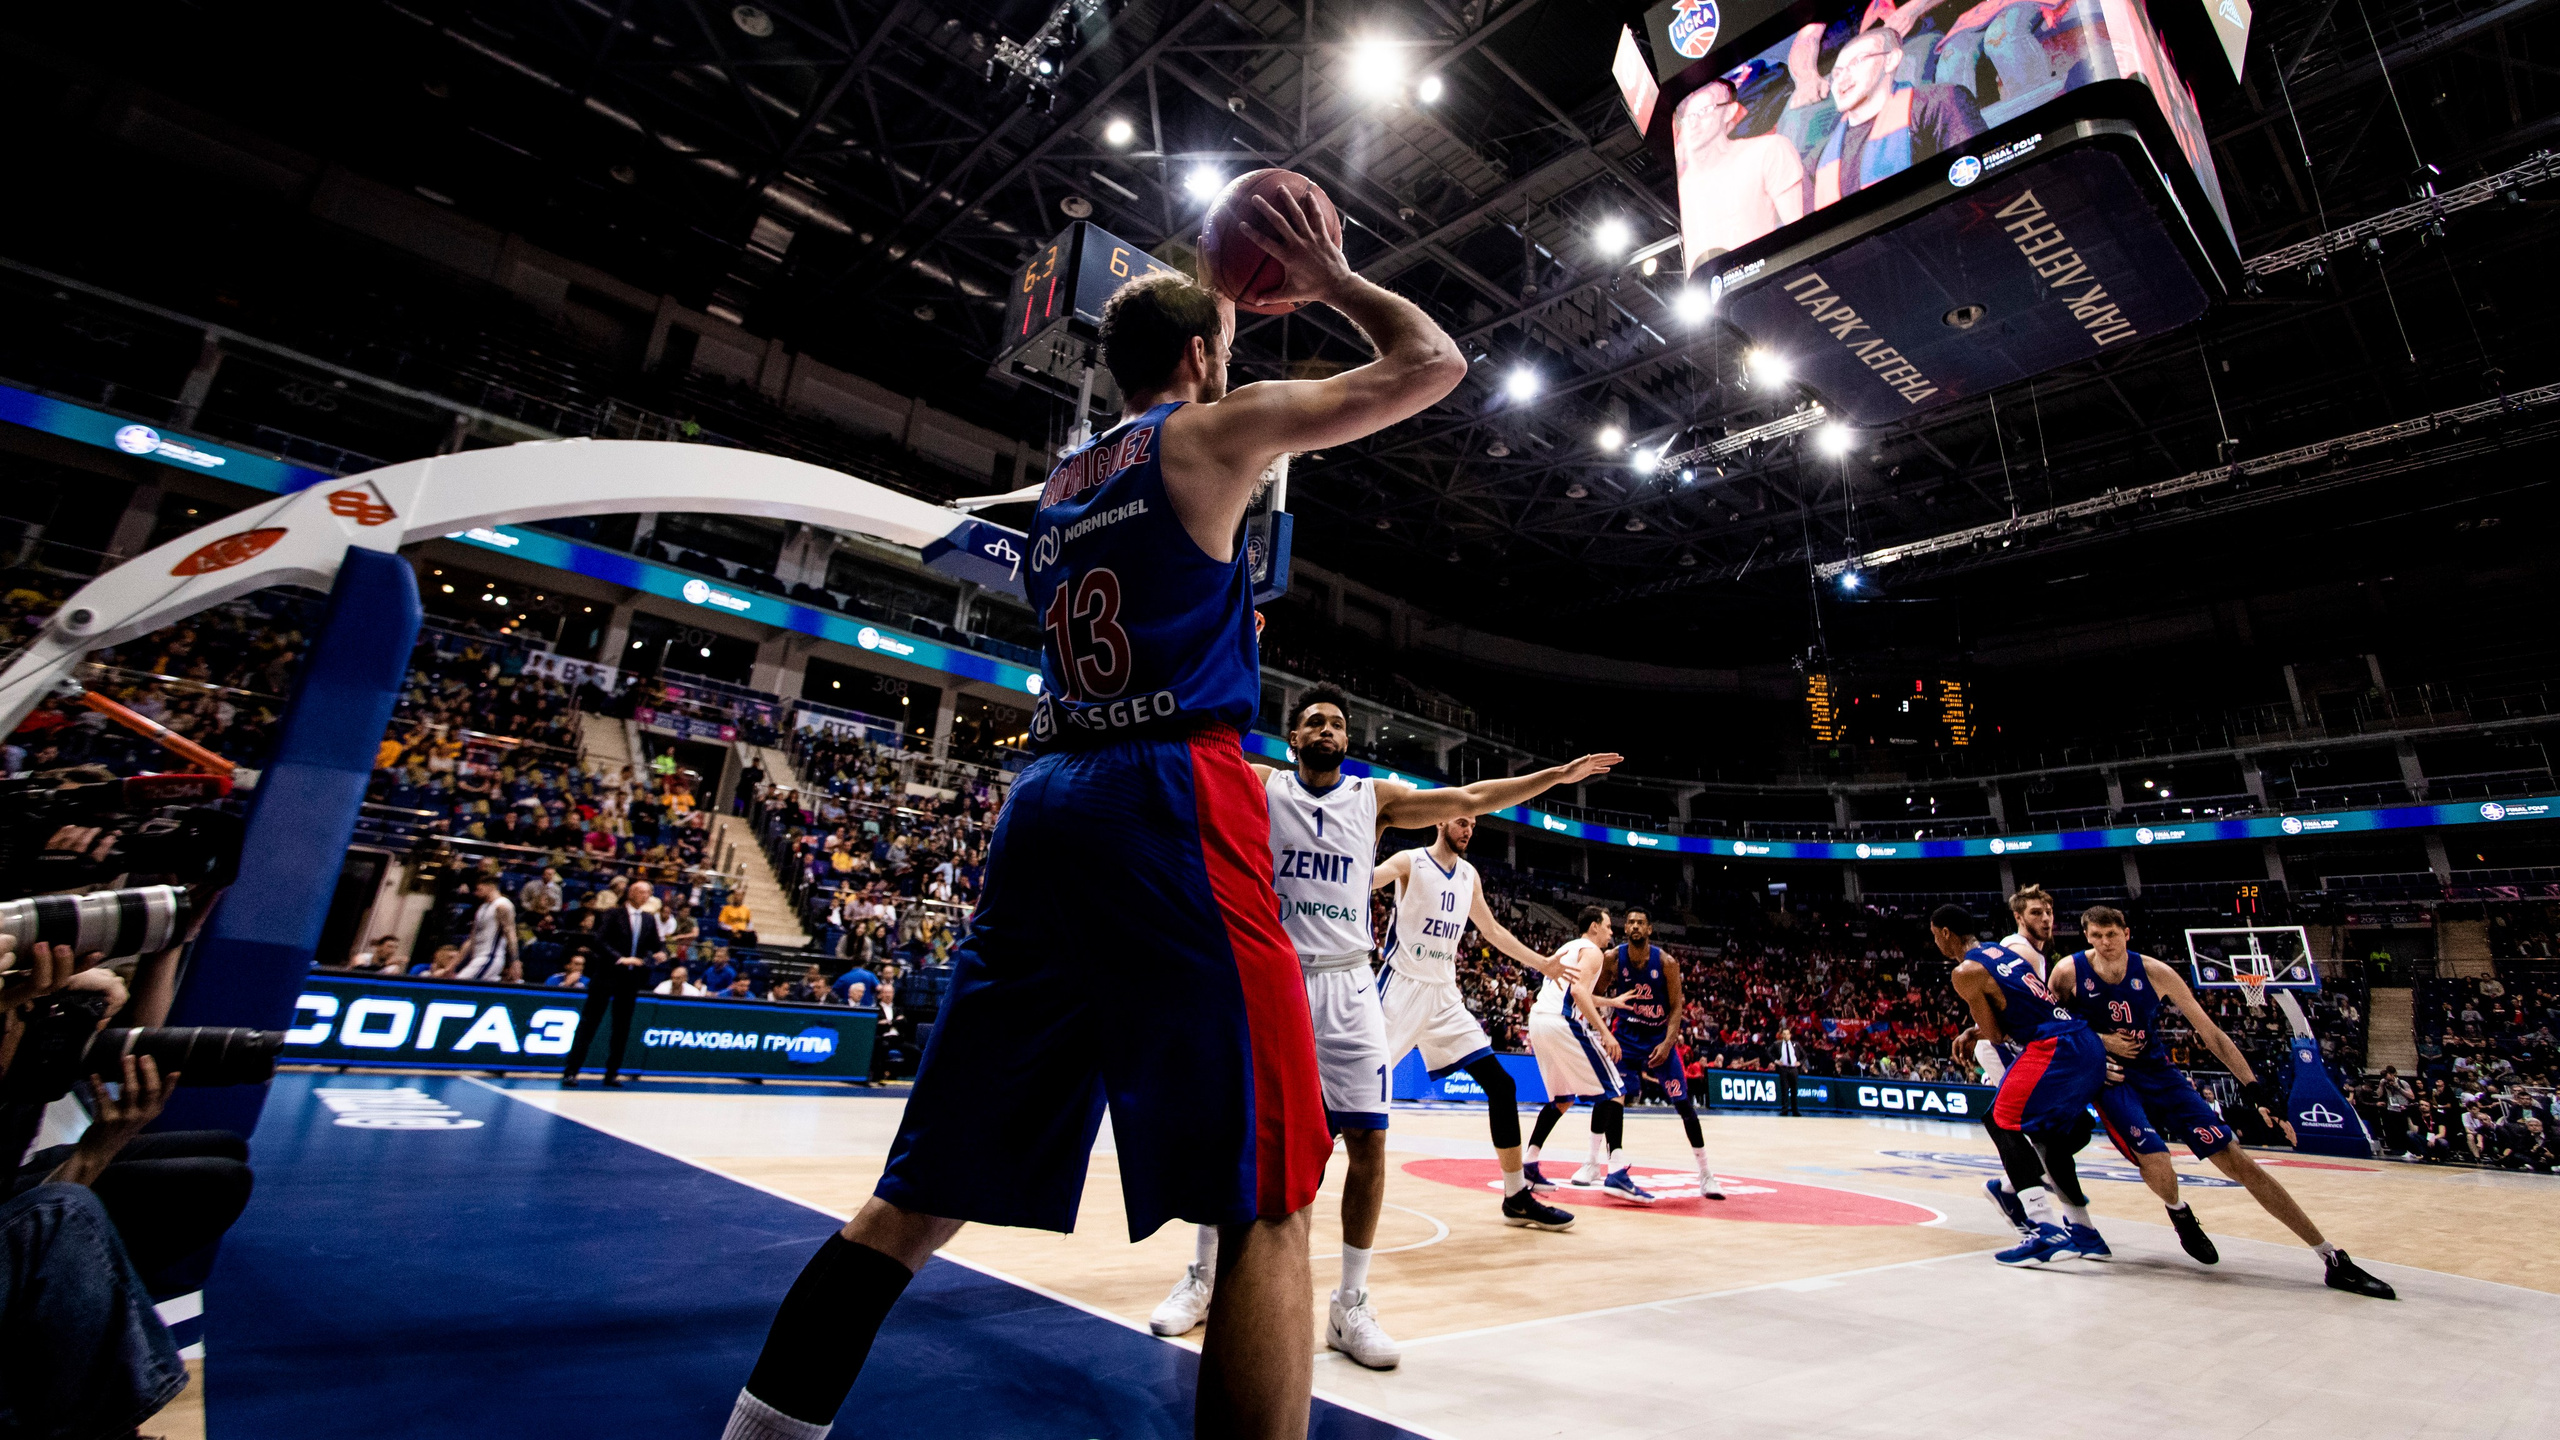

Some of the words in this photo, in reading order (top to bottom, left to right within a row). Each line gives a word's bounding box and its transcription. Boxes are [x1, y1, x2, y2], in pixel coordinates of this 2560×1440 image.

[1675, 7, 1714, 40] ЦСКА
[1982, 147, 2013, 166] FINAL
[2012, 133, 2043, 152] FOUR
[1783, 272, 1871, 341] ПАРК
[2062, 283, 2138, 346] ПАРК
[1040, 426, 1155, 512] RODRIGUEZ
[1064, 498, 1149, 543] NORNICKEL
[1046, 567, 1132, 702] 13
[872, 675, 909, 697] 308
[1312, 807, 1324, 838] 1
[1280, 849, 1354, 884] ZENIT
[1295, 901, 1357, 922] NIPIGAS
[1440, 890, 1456, 912] 10
[1422, 917, 1461, 941] ZENIT
[1634, 983, 1654, 1000] 22
[285, 994, 580, 1055] СОГАЗ
[2108, 1000, 2133, 1023] 31
[643, 1028, 759, 1049] СТРАХОВАЯ
[762, 1034, 833, 1054] ГРУППА
[1376, 1064, 1387, 1103] 1
[1721, 1077, 1777, 1102] СОГАЗ
[1858, 1086, 1969, 1115] СОГАЗ
[2193, 1124, 2224, 1145] 31
